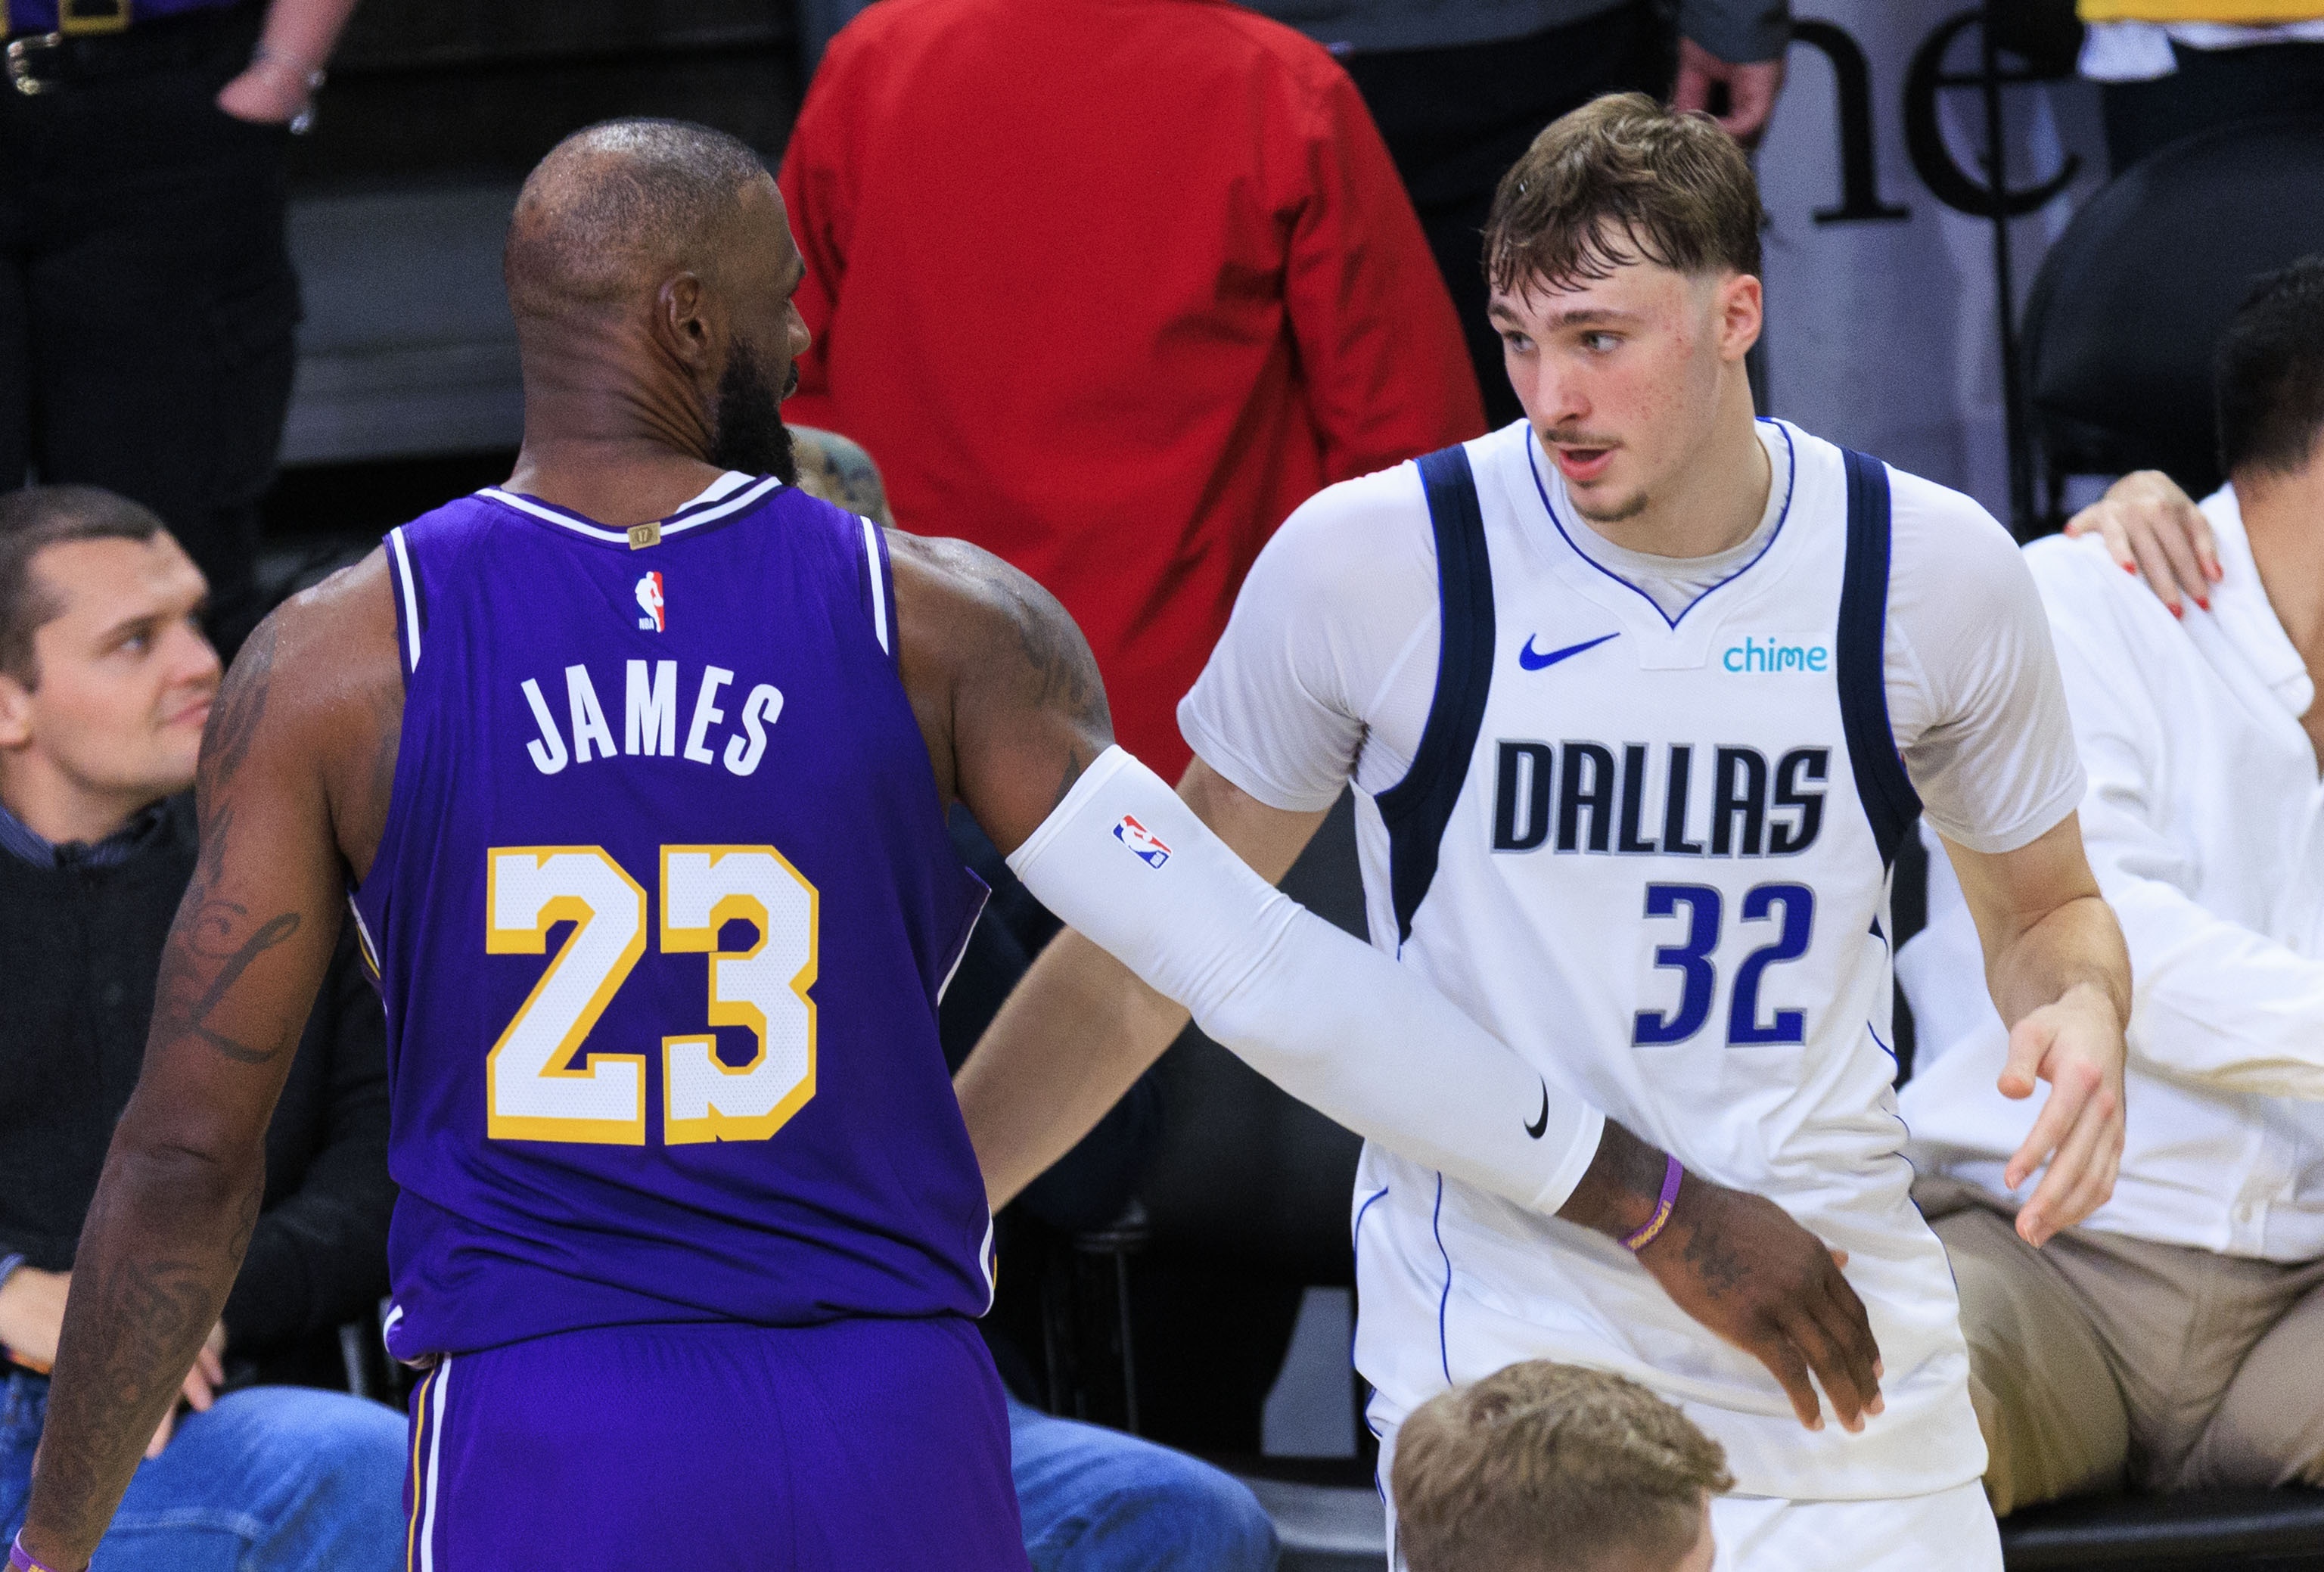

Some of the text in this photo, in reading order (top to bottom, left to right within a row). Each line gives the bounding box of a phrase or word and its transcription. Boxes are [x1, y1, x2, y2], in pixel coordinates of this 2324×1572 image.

[1723, 636, 1828, 672] chime
[520, 659, 784, 776] JAMES
[1490, 738, 1833, 859] DALLAS
[486, 843, 819, 1146] 23
[1631, 881, 1816, 1048] 32
